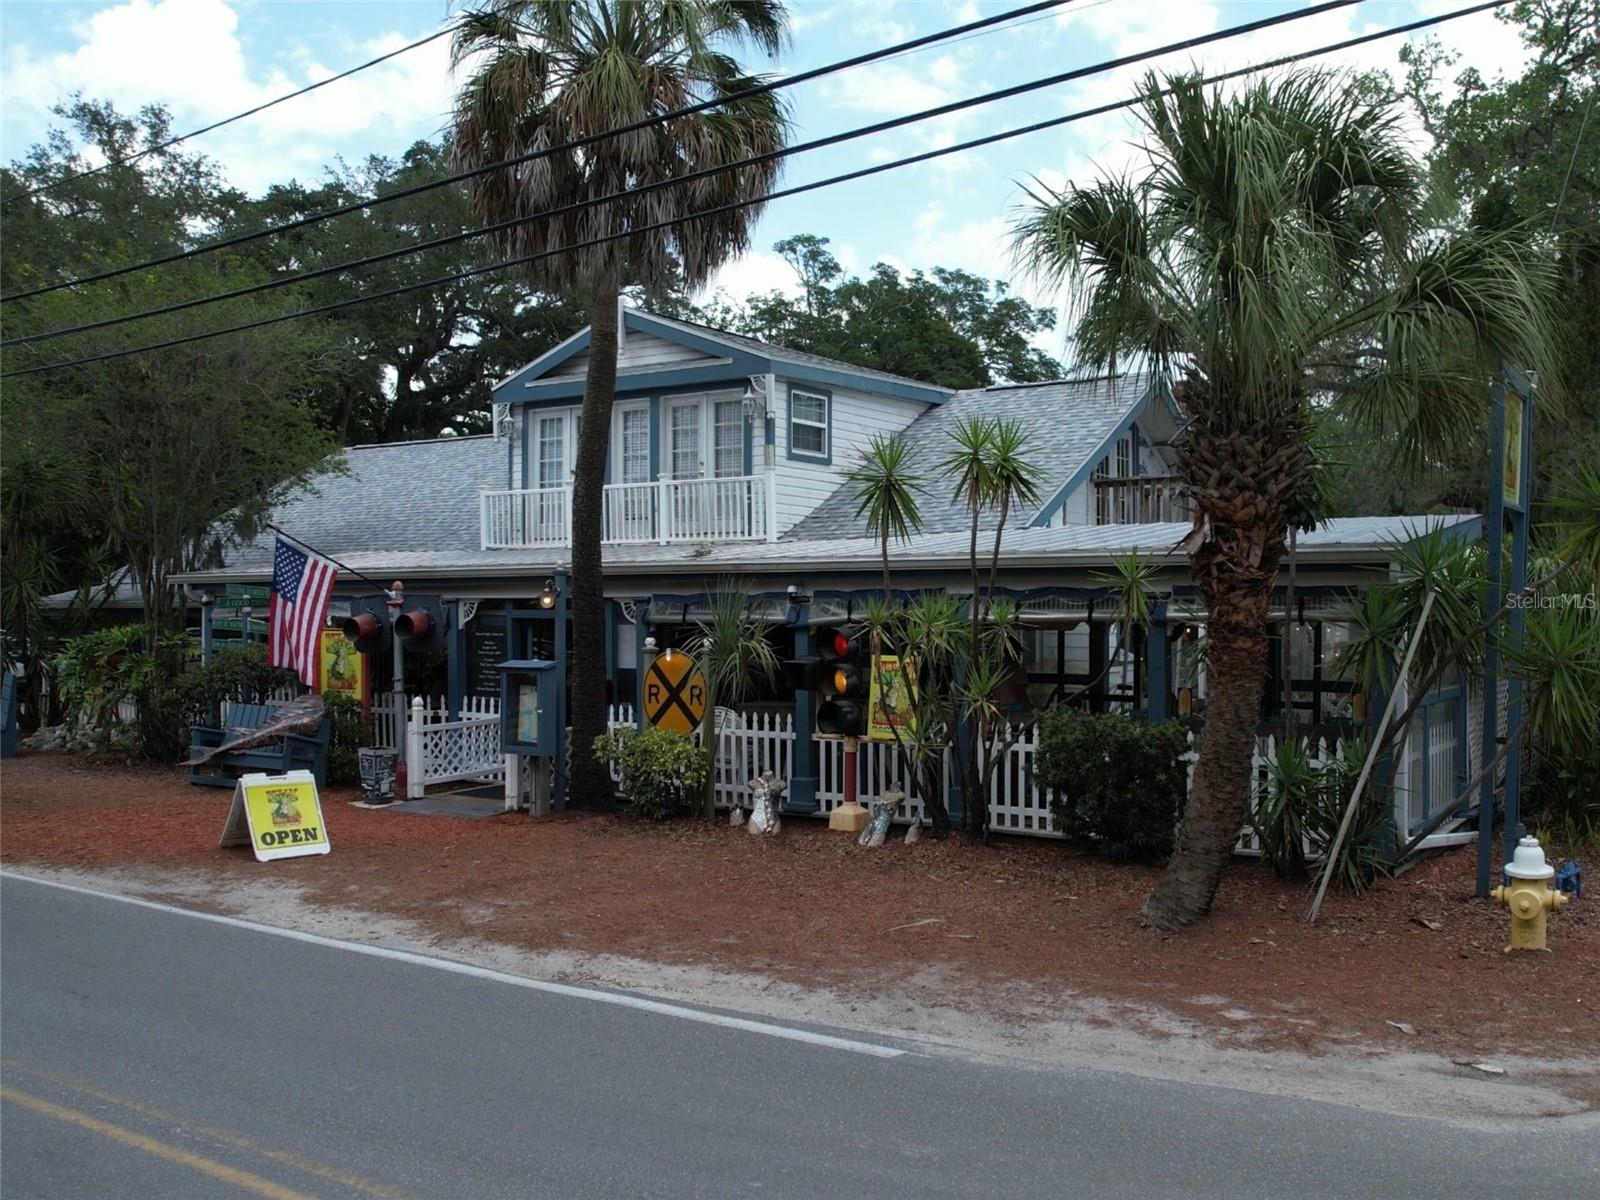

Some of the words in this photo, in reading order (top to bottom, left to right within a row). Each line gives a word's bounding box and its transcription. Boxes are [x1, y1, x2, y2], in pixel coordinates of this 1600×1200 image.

[648, 684, 660, 704] R
[690, 685, 703, 705] R
[261, 827, 318, 846] OPEN
